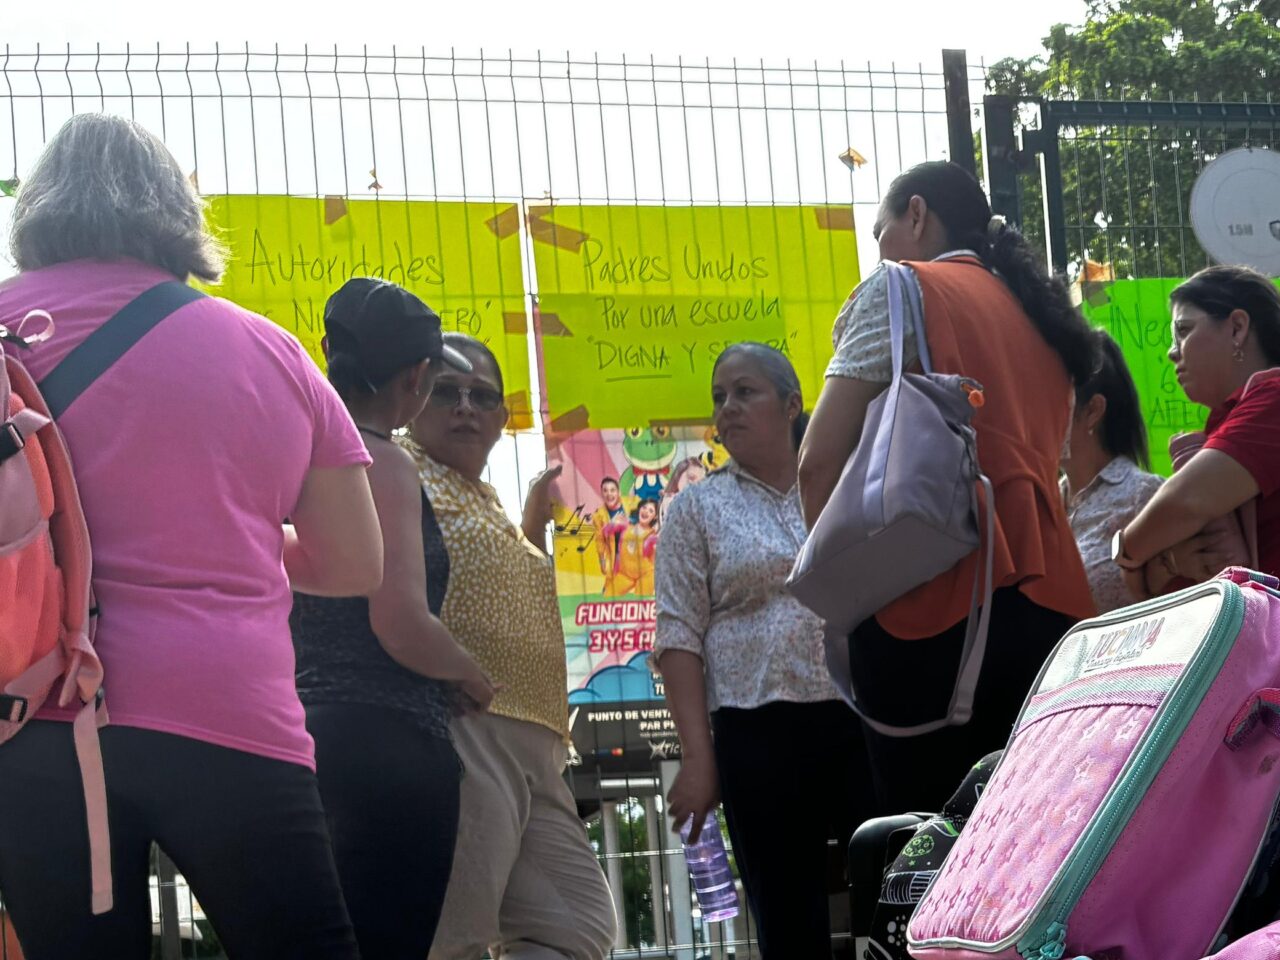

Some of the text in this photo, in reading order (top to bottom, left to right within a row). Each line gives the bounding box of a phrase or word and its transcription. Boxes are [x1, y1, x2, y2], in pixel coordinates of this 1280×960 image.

[246, 228, 444, 285] Autoridades
[576, 238, 769, 290] Padres Unidos
[596, 296, 629, 330] Por
[640, 304, 678, 329] una
[681, 343, 696, 373] Y
[577, 602, 656, 624] FUNCIONE
[590, 629, 656, 651] 3 Y 5 P
[625, 710, 639, 720] DE
[640, 708, 671, 719] VENT
